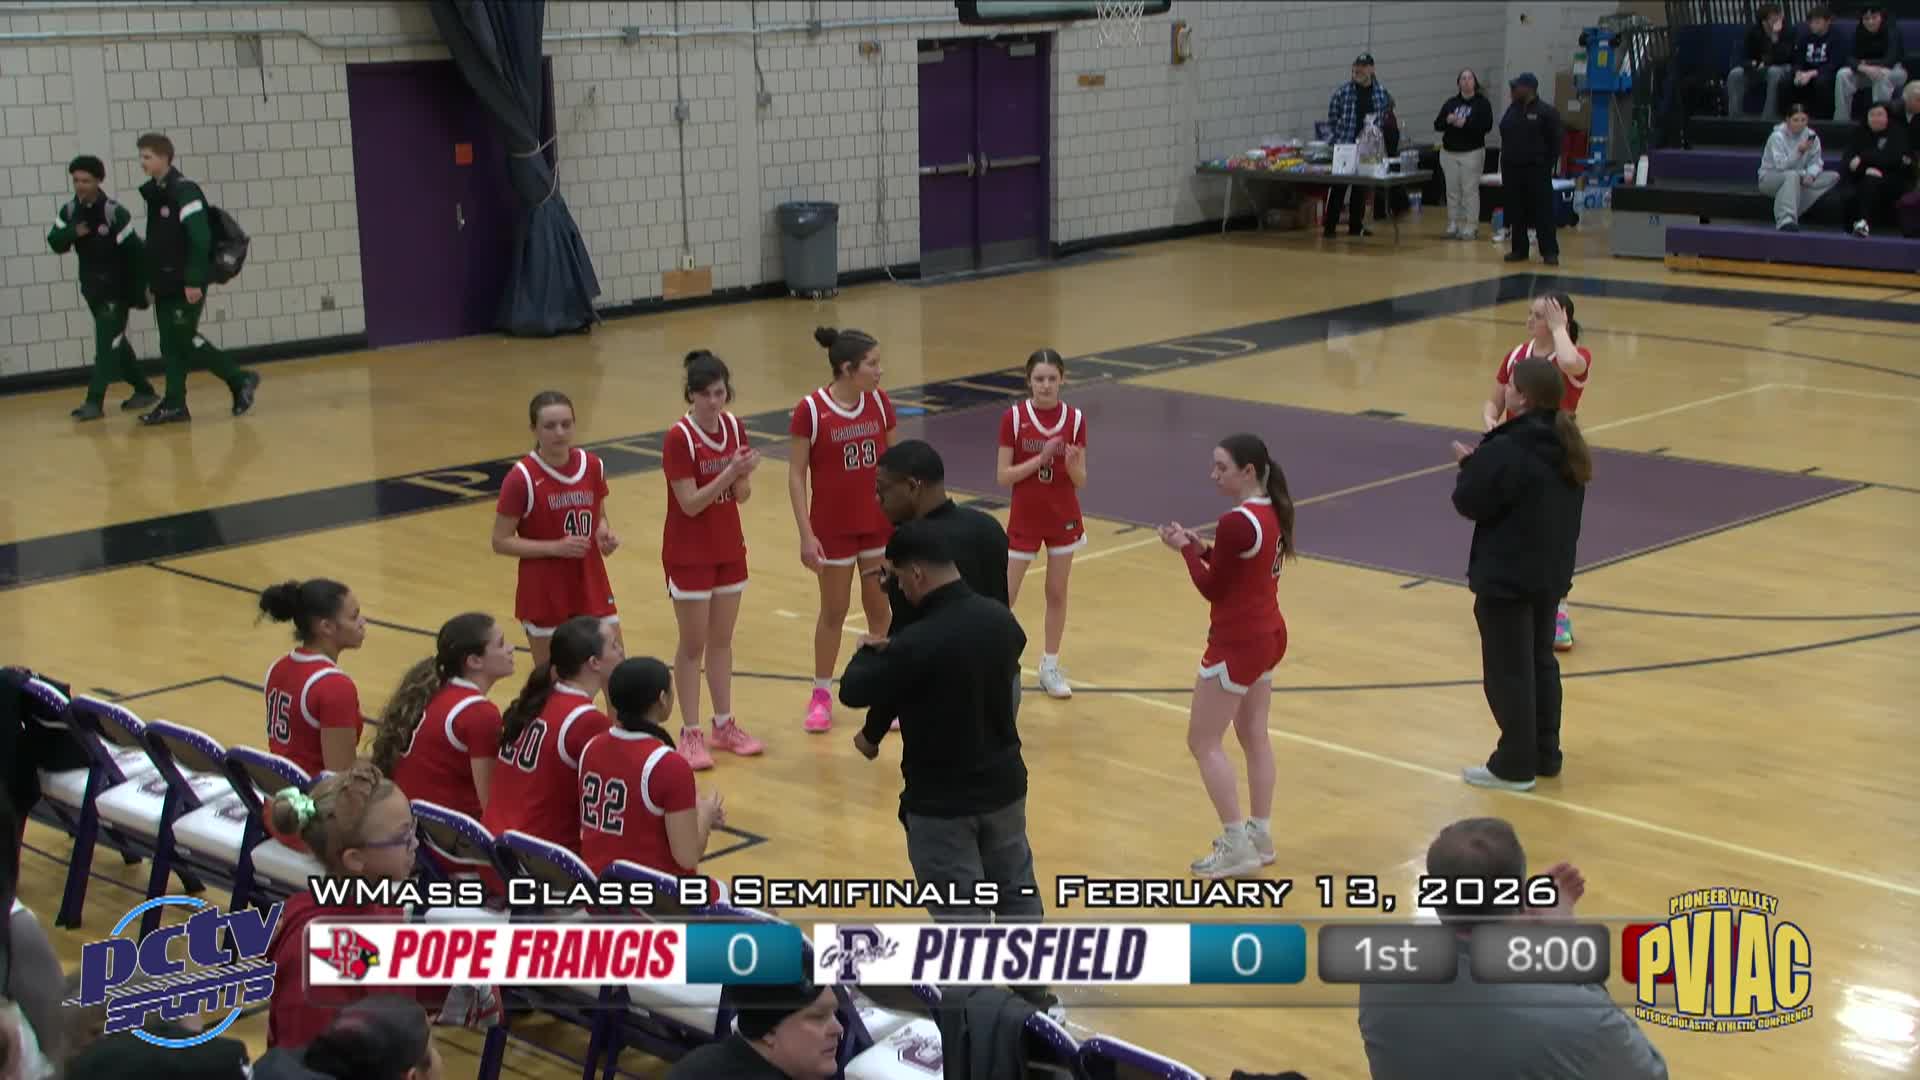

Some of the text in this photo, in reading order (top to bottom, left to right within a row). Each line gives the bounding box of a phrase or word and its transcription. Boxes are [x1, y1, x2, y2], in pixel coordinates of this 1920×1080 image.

[843, 439, 877, 470] 23
[563, 508, 592, 538] 40
[267, 688, 292, 745] 15
[581, 771, 627, 836] 22
